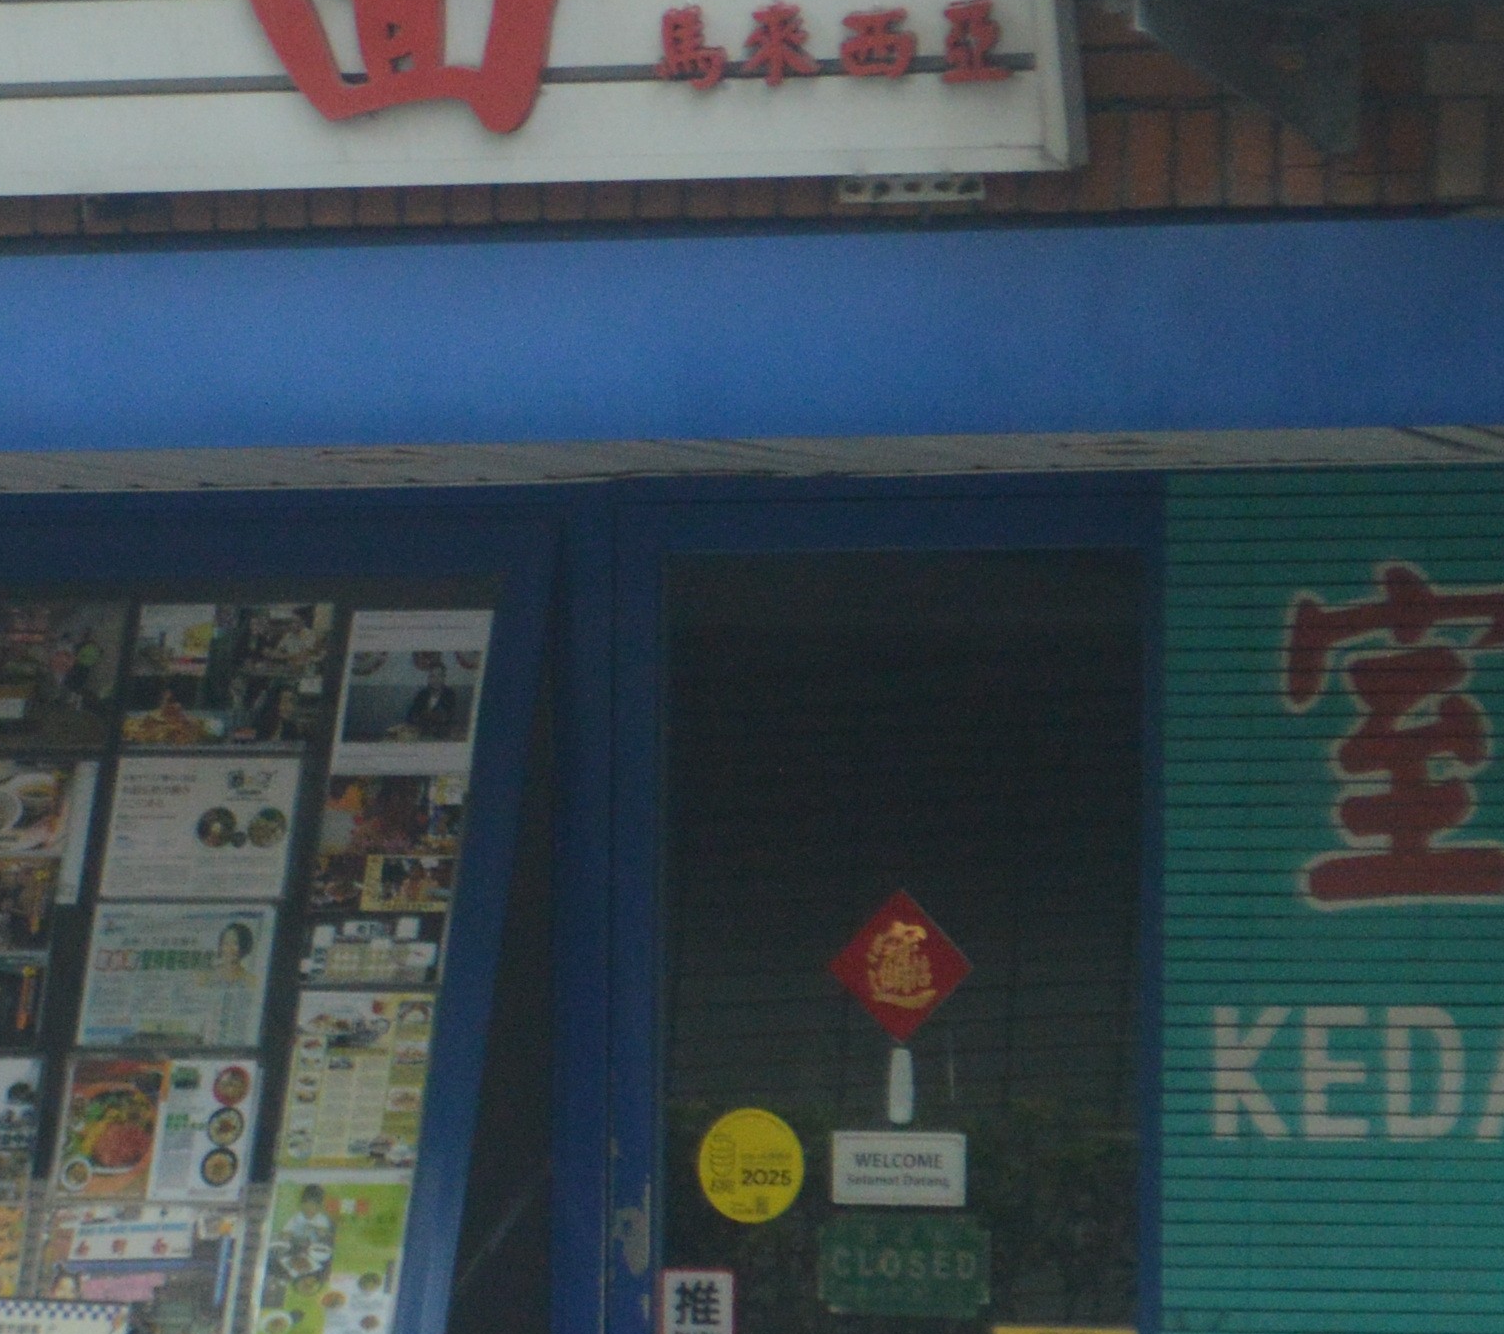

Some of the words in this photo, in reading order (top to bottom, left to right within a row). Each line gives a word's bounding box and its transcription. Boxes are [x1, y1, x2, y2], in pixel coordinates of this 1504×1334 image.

[854, 1152, 943, 1169] WELCOME
[741, 1168, 792, 1186] 2025
[831, 1246, 976, 1280] CLOSED
[674, 1278, 721, 1325] 推
